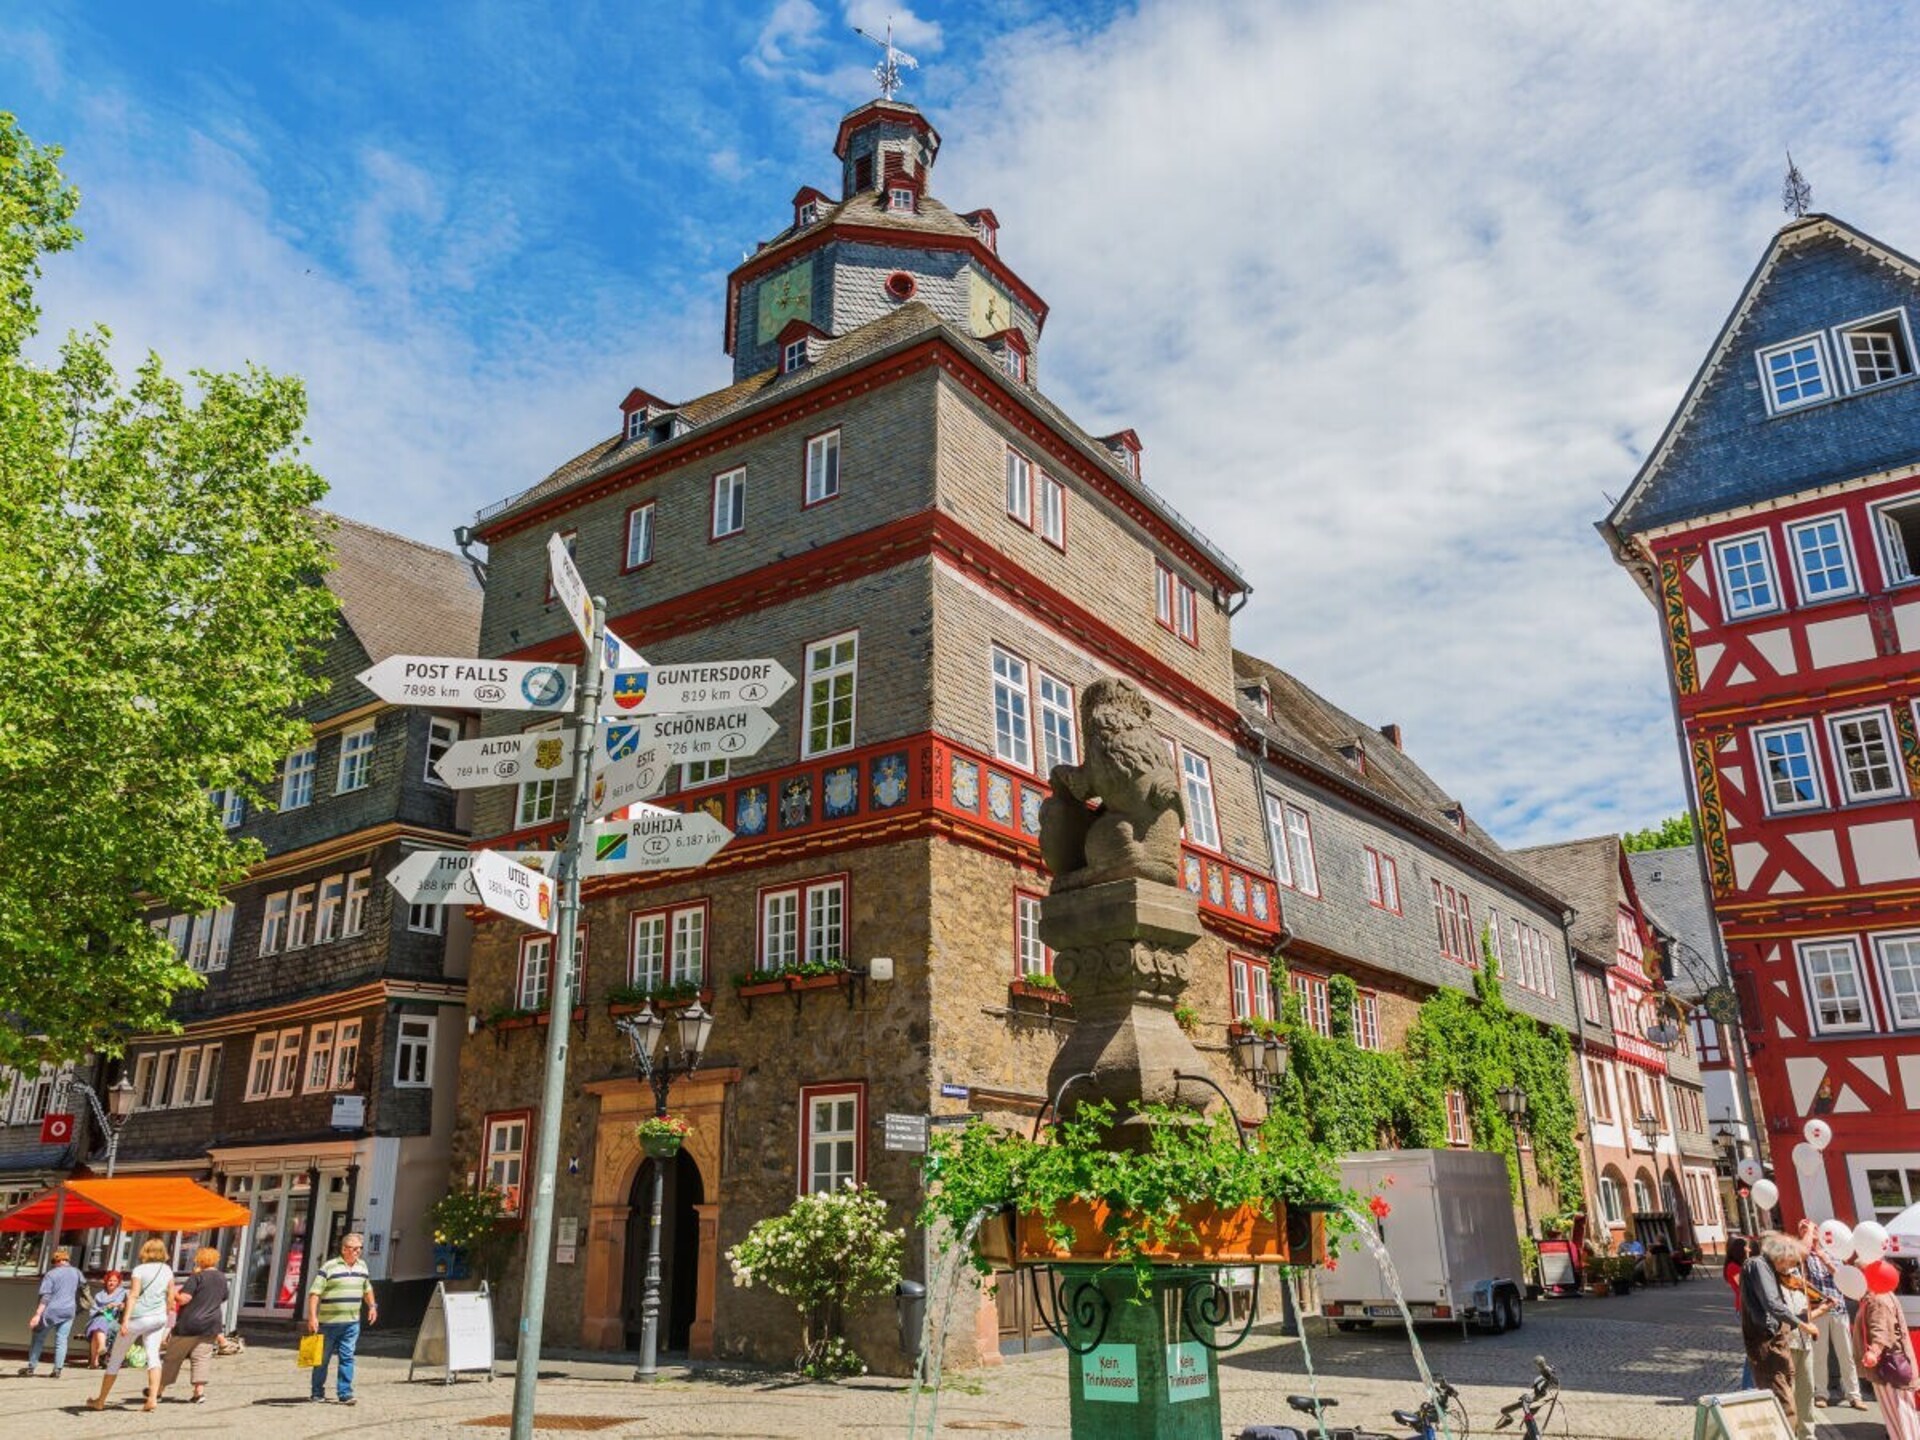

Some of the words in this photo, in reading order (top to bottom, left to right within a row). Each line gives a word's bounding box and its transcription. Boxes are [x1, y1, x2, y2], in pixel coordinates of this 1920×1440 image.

[405, 663, 449, 680] POST
[455, 666, 509, 682] FALLS
[657, 665, 772, 685] GUNTERSDORF
[403, 684, 436, 698] 7898
[441, 685, 460, 698] km
[477, 688, 501, 699] USA
[681, 690, 707, 703] 819
[712, 688, 731, 700] km
[749, 687, 757, 698] A
[654, 713, 747, 738] SCHÖNBACH
[481, 740, 521, 756] ALTON
[694, 740, 711, 752] km
[729, 737, 737, 748] A
[636, 748, 656, 768] ESTE
[476, 765, 489, 776] km
[499, 762, 514, 774] GB
[632, 818, 683, 836] RUHIJA
[650, 841, 662, 851] TZ
[676, 836, 702, 848] 6.187
[508, 865, 530, 888] UTIEL
[441, 879, 457, 891] km
[1099, 1356, 1119, 1369] Kein
[1179, 1355, 1195, 1368] Kein
[1085, 1372, 1135, 1388] Trinkwasser
[1169, 1373, 1207, 1387] Trinkwasser
